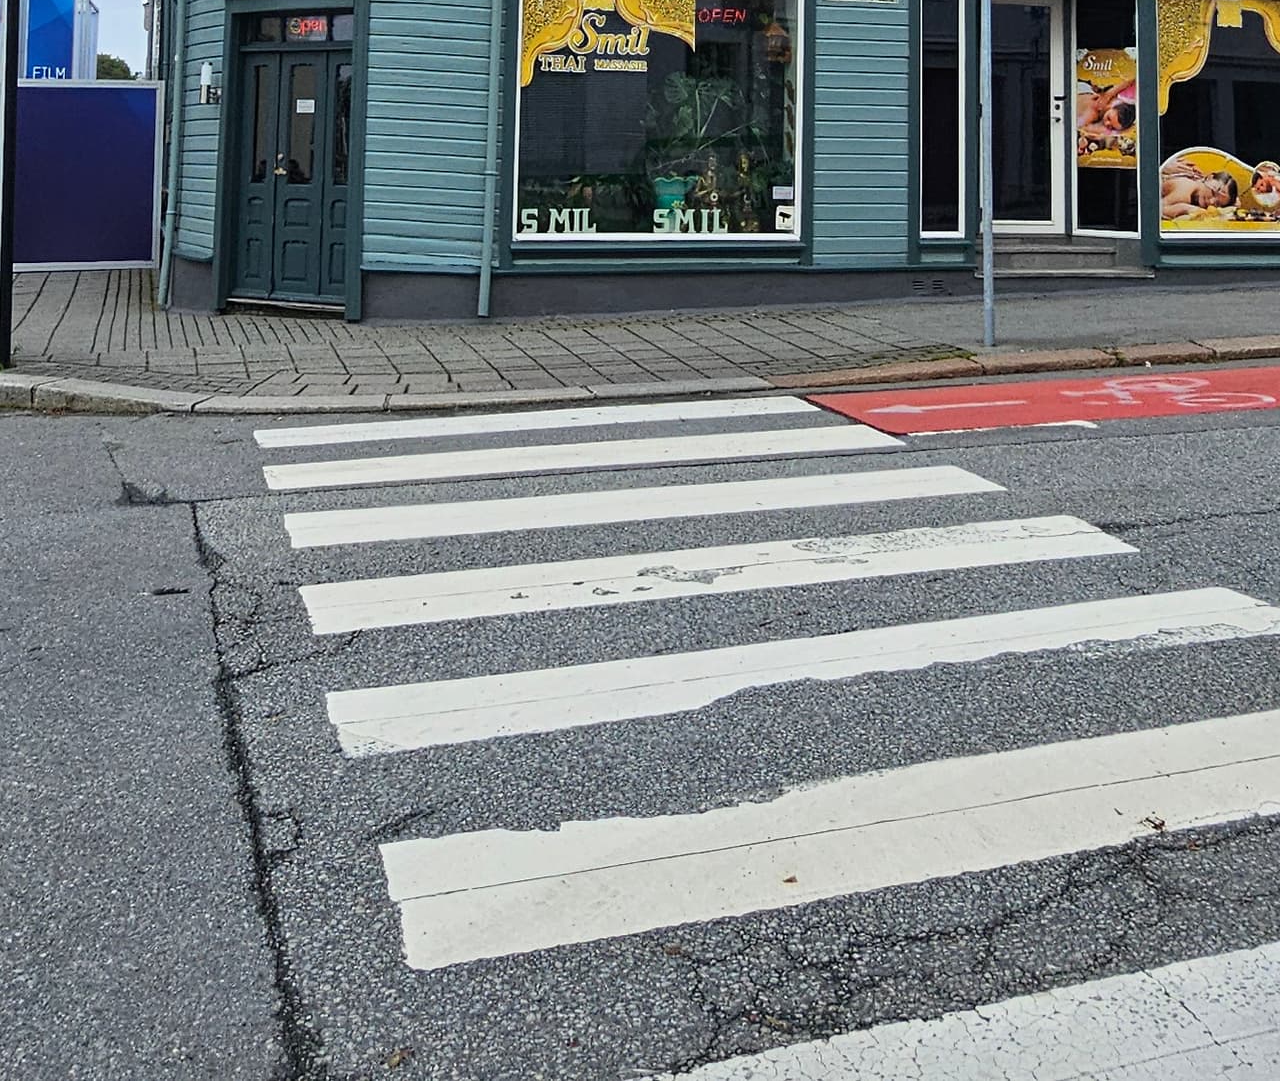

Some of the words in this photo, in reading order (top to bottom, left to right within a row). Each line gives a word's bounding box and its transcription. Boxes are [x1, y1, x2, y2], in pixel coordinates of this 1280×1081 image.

[698, 7, 747, 25] OPEN
[568, 12, 650, 56] Smil
[32, 66, 66, 79] FILM
[538, 54, 587, 73] THAI
[653, 207, 728, 233] SMIL
